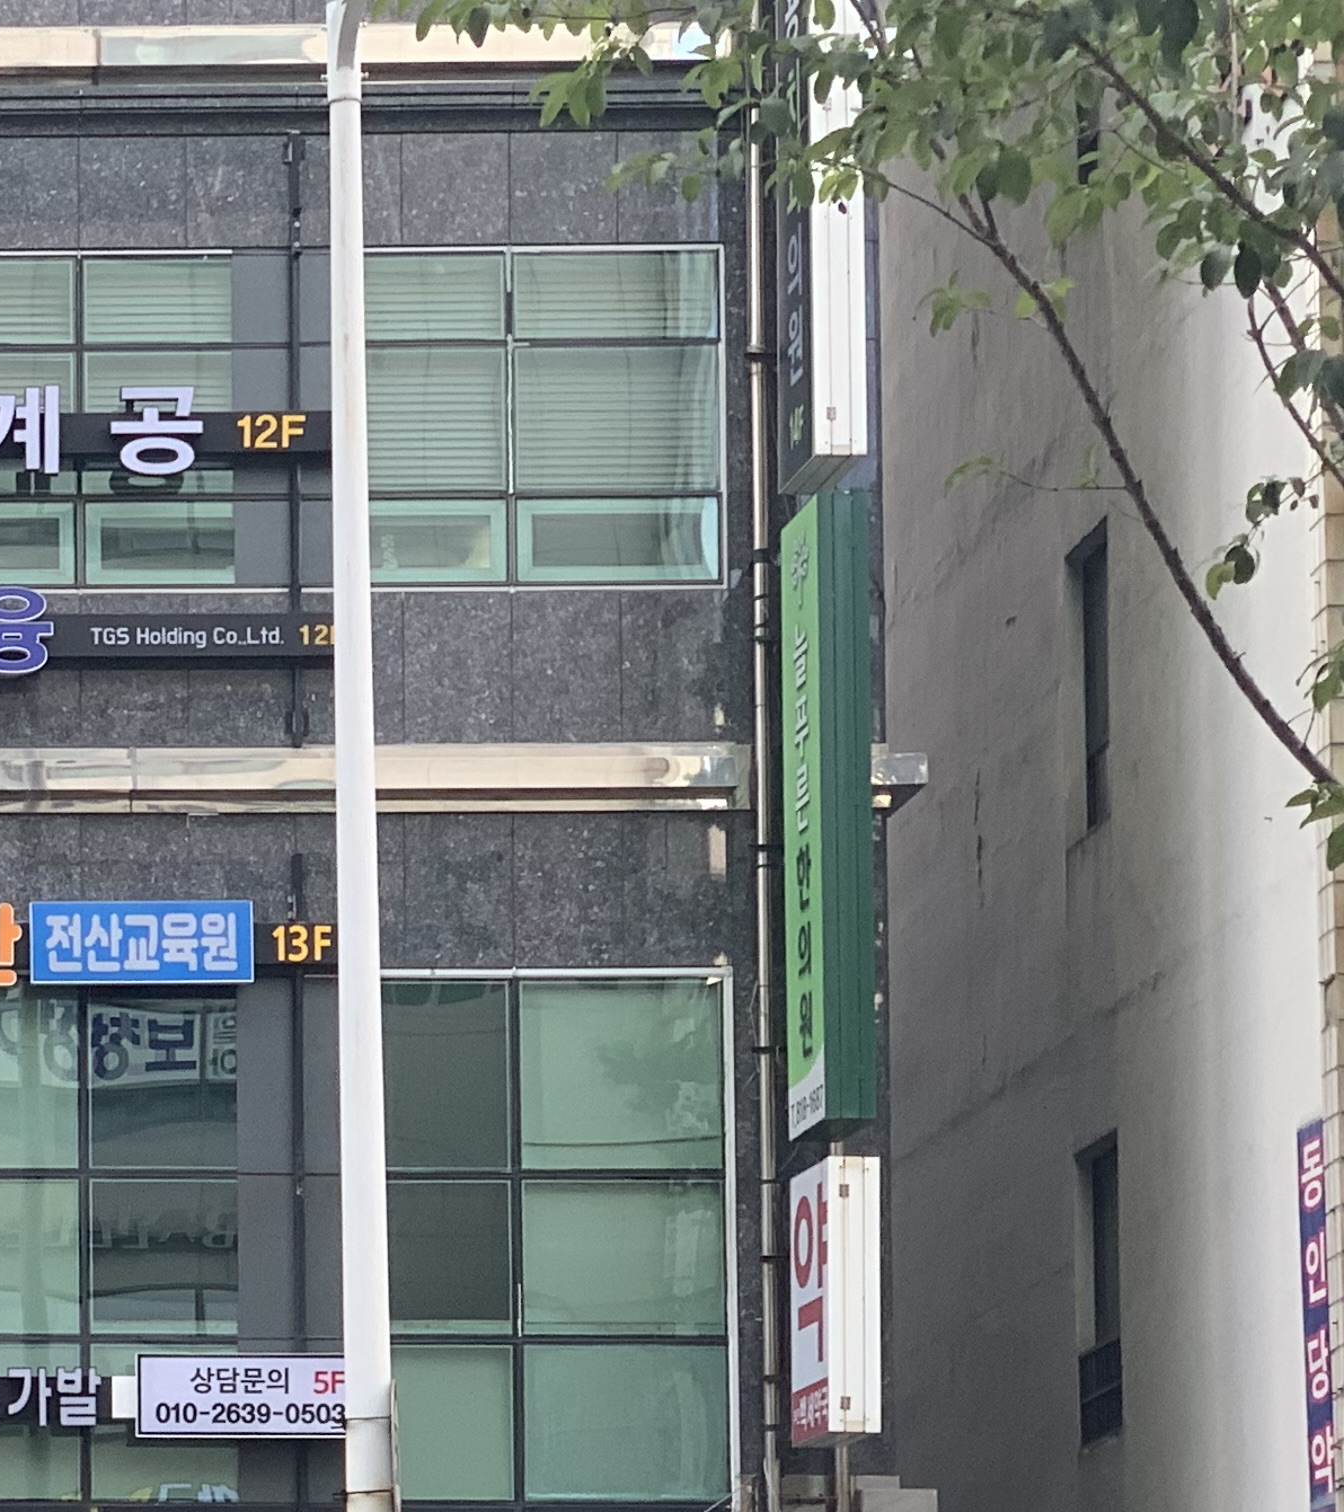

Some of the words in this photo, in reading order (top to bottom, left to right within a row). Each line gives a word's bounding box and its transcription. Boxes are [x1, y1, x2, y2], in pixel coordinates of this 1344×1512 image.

[109, 385, 205, 476] 공
[237, 413, 306, 449] 12F
[91, 627, 130, 645] TGS
[136, 627, 207, 649] Holding
[298, 625, 334, 646] 12
[44, 912, 241, 974] 전산교육원
[272, 923, 333, 963] 13F
[188, 1366, 291, 1395] 상담문의
[313, 1371, 346, 1396] 5F
[154, 1403, 346, 1427] 010-2639-0503
